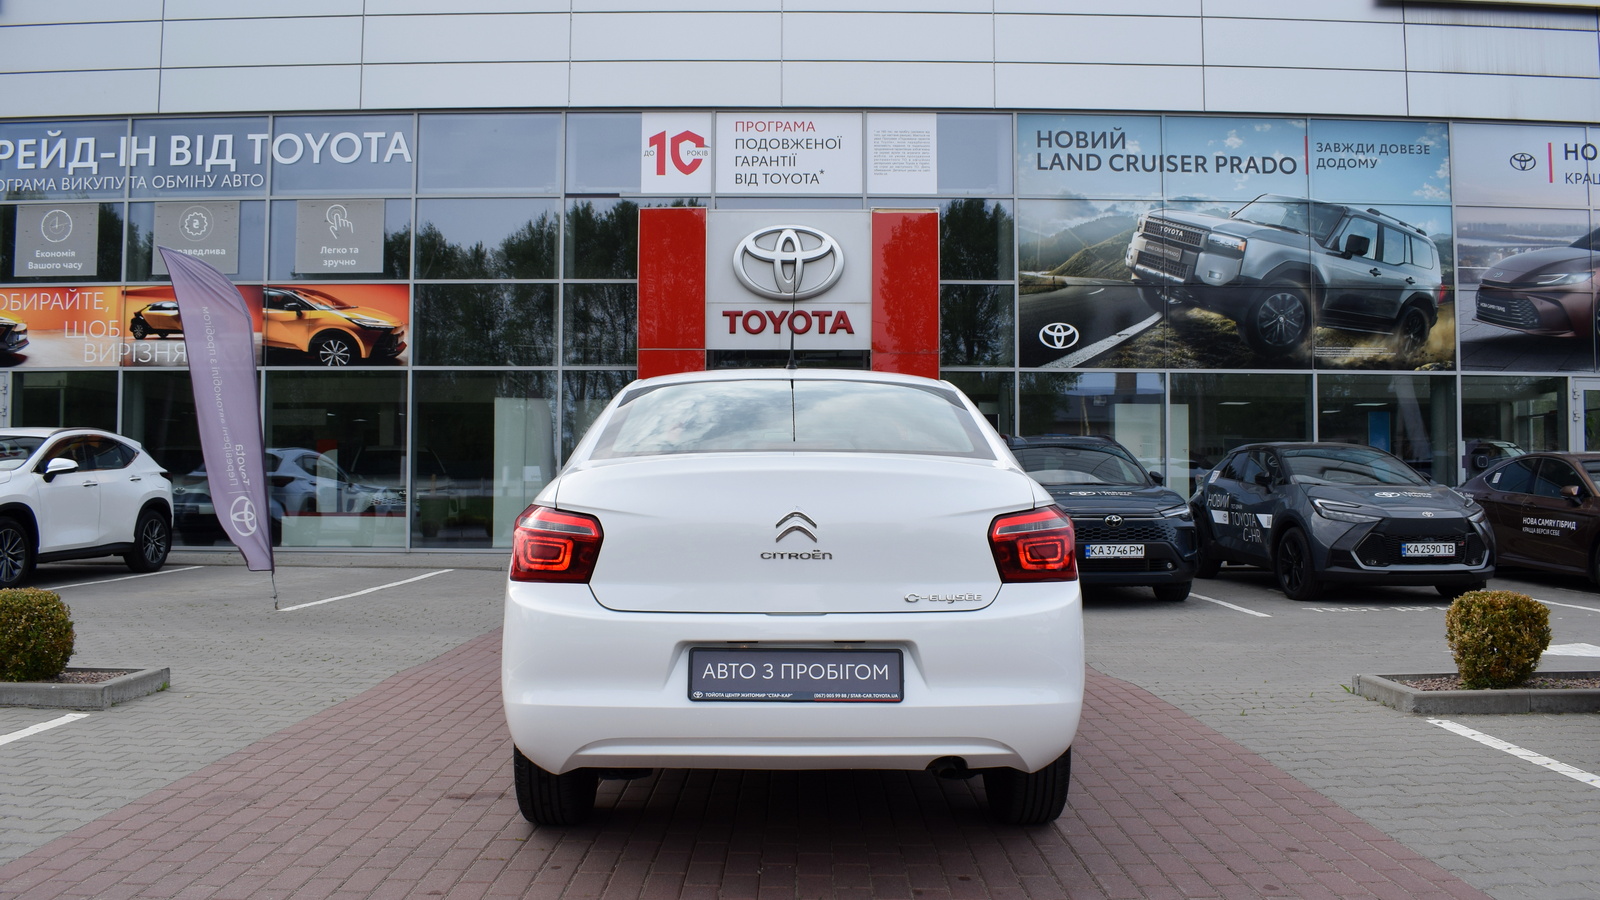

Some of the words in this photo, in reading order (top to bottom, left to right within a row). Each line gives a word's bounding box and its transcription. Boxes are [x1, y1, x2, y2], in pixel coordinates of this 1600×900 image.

[735, 121, 816, 132] ПРОГРАМА
[735, 136, 842, 152] ПОДОВЖЕНОЇ
[1036, 126, 1126, 150] НОВИЙ
[170, 134, 237, 172] ВІД
[248, 131, 412, 165] TOYOTA
[649, 130, 704, 175] 10
[1316, 142, 1375, 155] ЗАВЖДИ
[1379, 144, 1430, 156] ДОВЕЗЕ
[735, 153, 797, 167] ГАРАНТІЇ
[1037, 153, 1102, 171] LAND
[1109, 154, 1208, 173] CRUISER
[1216, 156, 1297, 175] PRADO
[1316, 158, 1378, 170] ДОДОМУ
[61, 176, 126, 191] ВИКУПУ
[130, 175, 148, 189] ТА
[152, 174, 218, 189] ОБМІНУ
[221, 173, 264, 188] АВТО
[735, 173, 759, 186] ВІД
[35, 249, 76, 258] Економія
[320, 246, 347, 254] Легко
[28, 261, 61, 270] Вашого
[62, 262, 83, 270] часу
[322, 258, 356, 267] зручно
[722, 309, 855, 335] TOYOTA
[64, 320, 121, 341] ЩОБ
[84, 342, 188, 363] ВИРІЗНЯ
[1207, 492, 1230, 508] НОВИЙ
[1231, 511, 1257, 527] TOYOTA
[1243, 528, 1262, 543] C-HR
[760, 549, 833, 560] CITROËN
[1106, 546, 1128, 555] 3746
[1420, 545, 1441, 554] 2590
[702, 663, 756, 679] АВТО
[762, 663, 774, 680] З
[781, 663, 889, 680] ПРОБІГОМ
